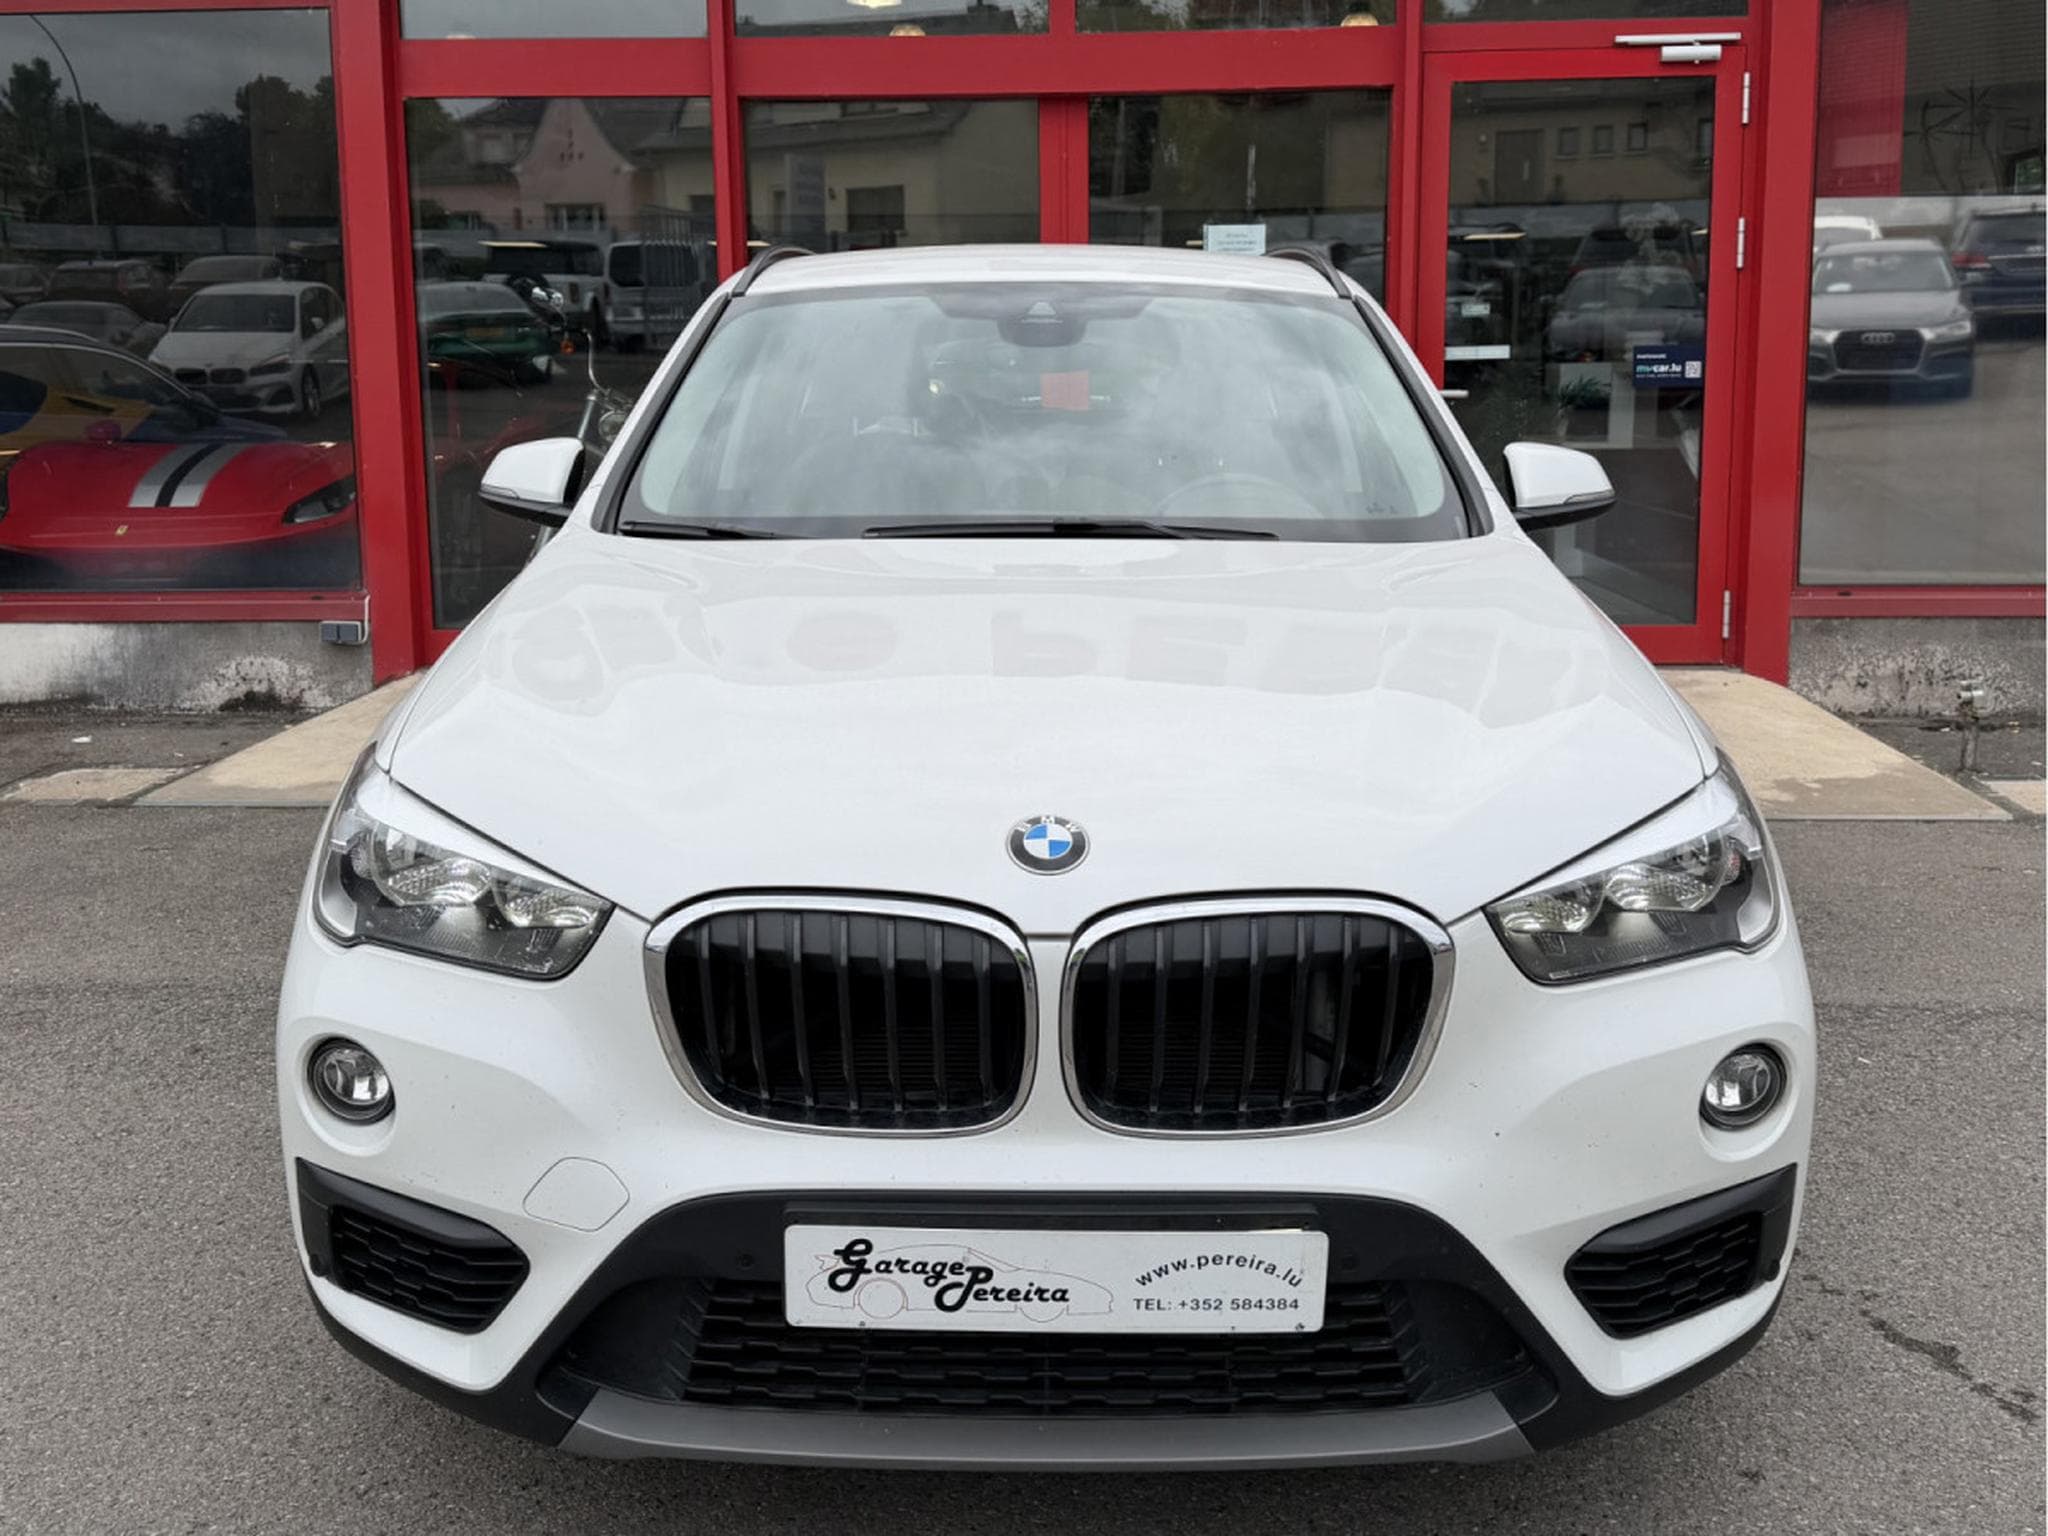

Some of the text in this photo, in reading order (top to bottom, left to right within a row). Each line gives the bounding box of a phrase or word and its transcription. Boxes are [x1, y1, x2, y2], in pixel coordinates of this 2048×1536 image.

[1014, 816, 1082, 832] BMW
[828, 1238, 966, 1292] Garage
[1135, 1253, 1303, 1288] www.pereira.lu
[934, 1265, 1069, 1313] Pereira
[1133, 1298, 1299, 1311] TEL: +352 584384
